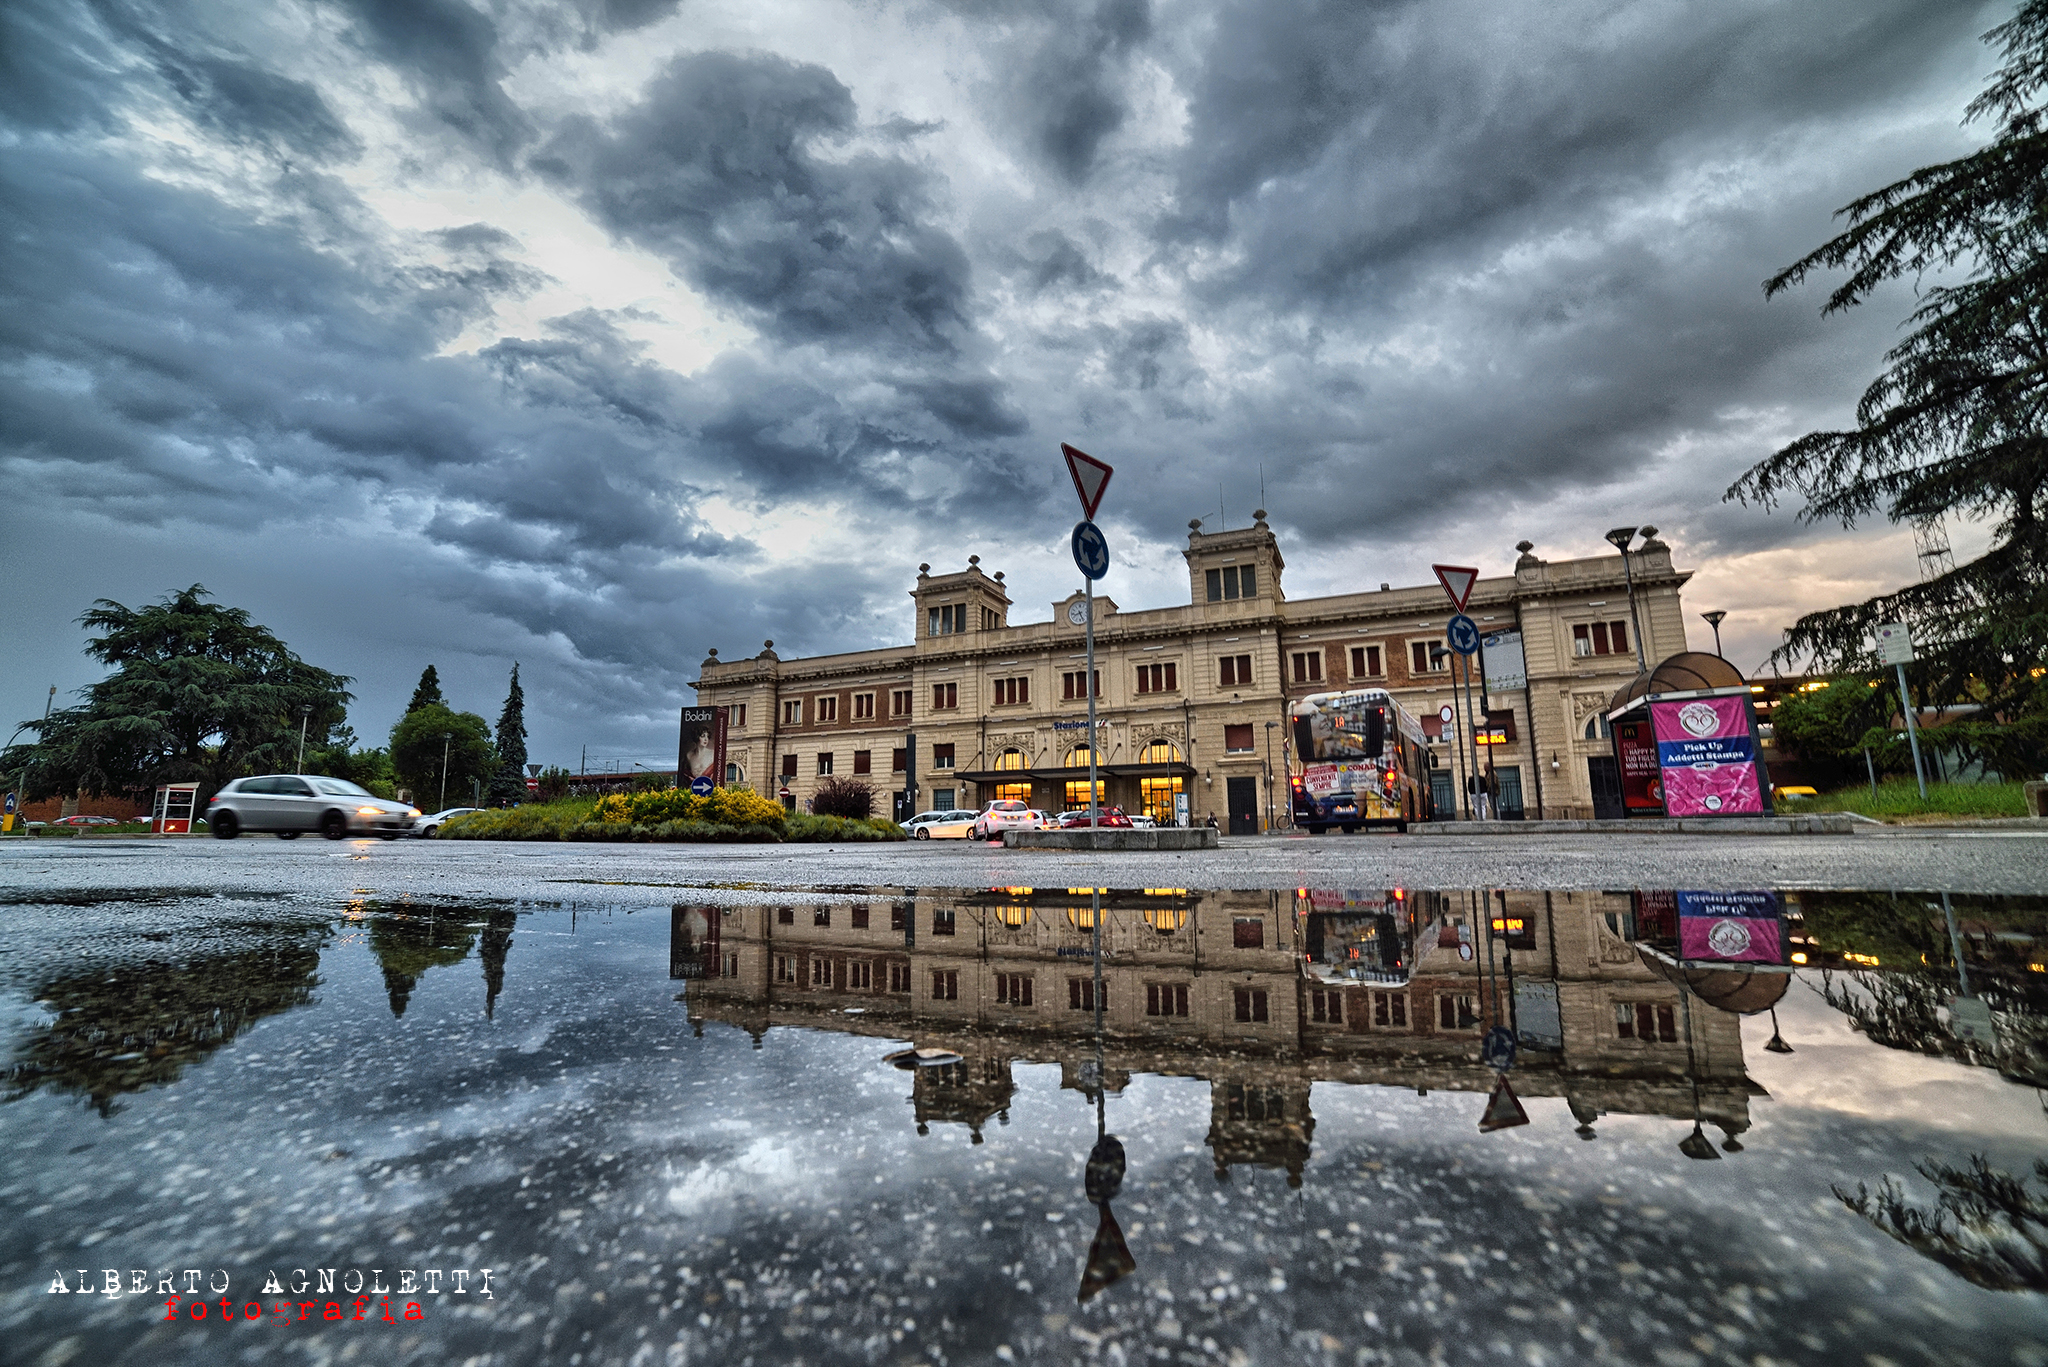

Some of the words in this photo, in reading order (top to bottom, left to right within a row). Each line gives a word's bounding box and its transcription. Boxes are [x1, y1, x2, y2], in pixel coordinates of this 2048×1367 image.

[685, 710, 713, 722] Boldini
[1335, 716, 1345, 728] 1A
[1684, 743, 1706, 752] Pick
[1708, 742, 1723, 751] Up
[1667, 753, 1704, 763] Addetti
[1705, 751, 1745, 761] Stampa
[1347, 763, 1376, 772] CONAD
[1306, 773, 1337, 784] CONVENIENTE
[1312, 781, 1332, 791] SEMPRE
